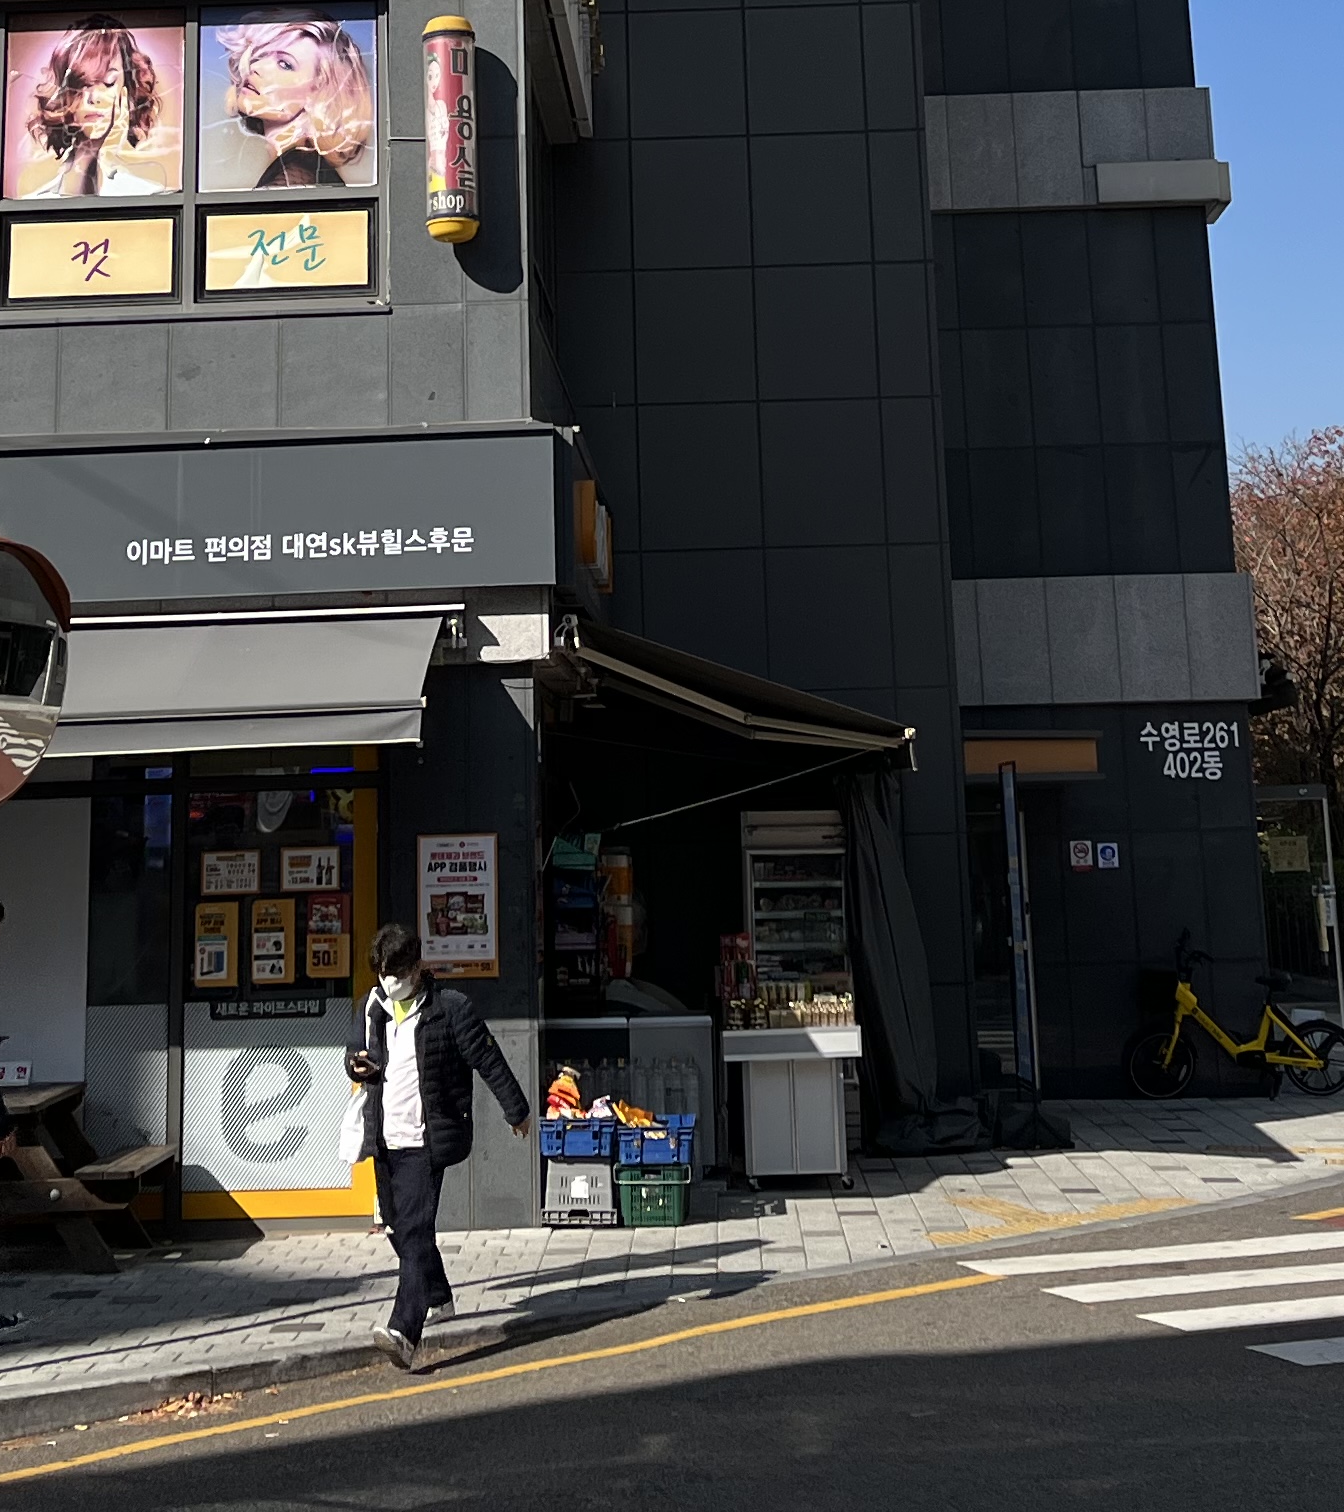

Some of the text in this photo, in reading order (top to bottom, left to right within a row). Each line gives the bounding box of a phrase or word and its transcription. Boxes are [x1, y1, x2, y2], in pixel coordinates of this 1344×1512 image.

[72, 238, 112, 282] 컷
[248, 224, 327, 272] 전문
[126, 525, 475, 566] 이마트 편의점 대연sk뷰힐스후문
[1140, 721, 1240, 751] 수영로261
[1163, 751, 1224, 781] 402동
[216, 999, 319, 1016] 새로운 라이프스타일
